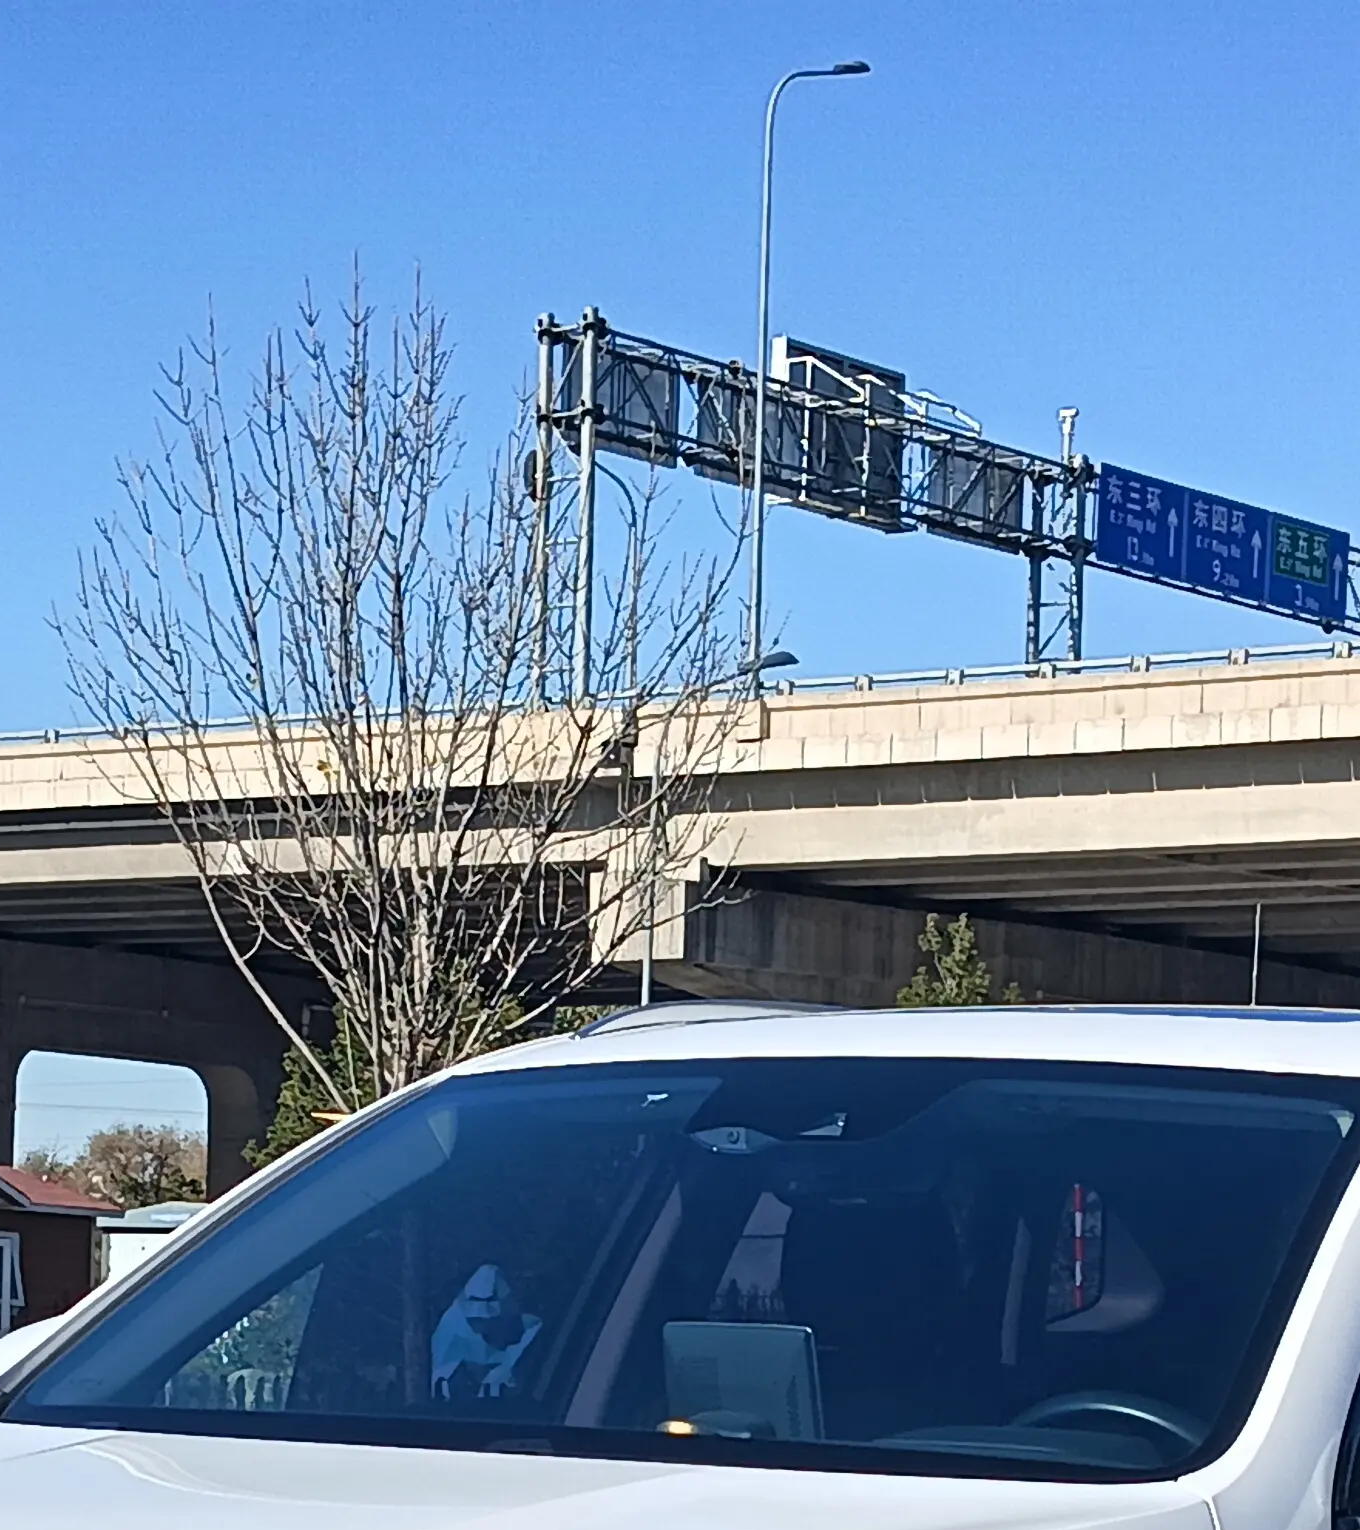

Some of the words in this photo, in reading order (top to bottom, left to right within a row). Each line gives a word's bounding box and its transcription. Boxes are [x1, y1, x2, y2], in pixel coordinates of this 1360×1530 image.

[1106, 474, 1163, 517] 东三环
[1193, 499, 1246, 539] 东四环
[1276, 527, 1328, 563] 东五环
